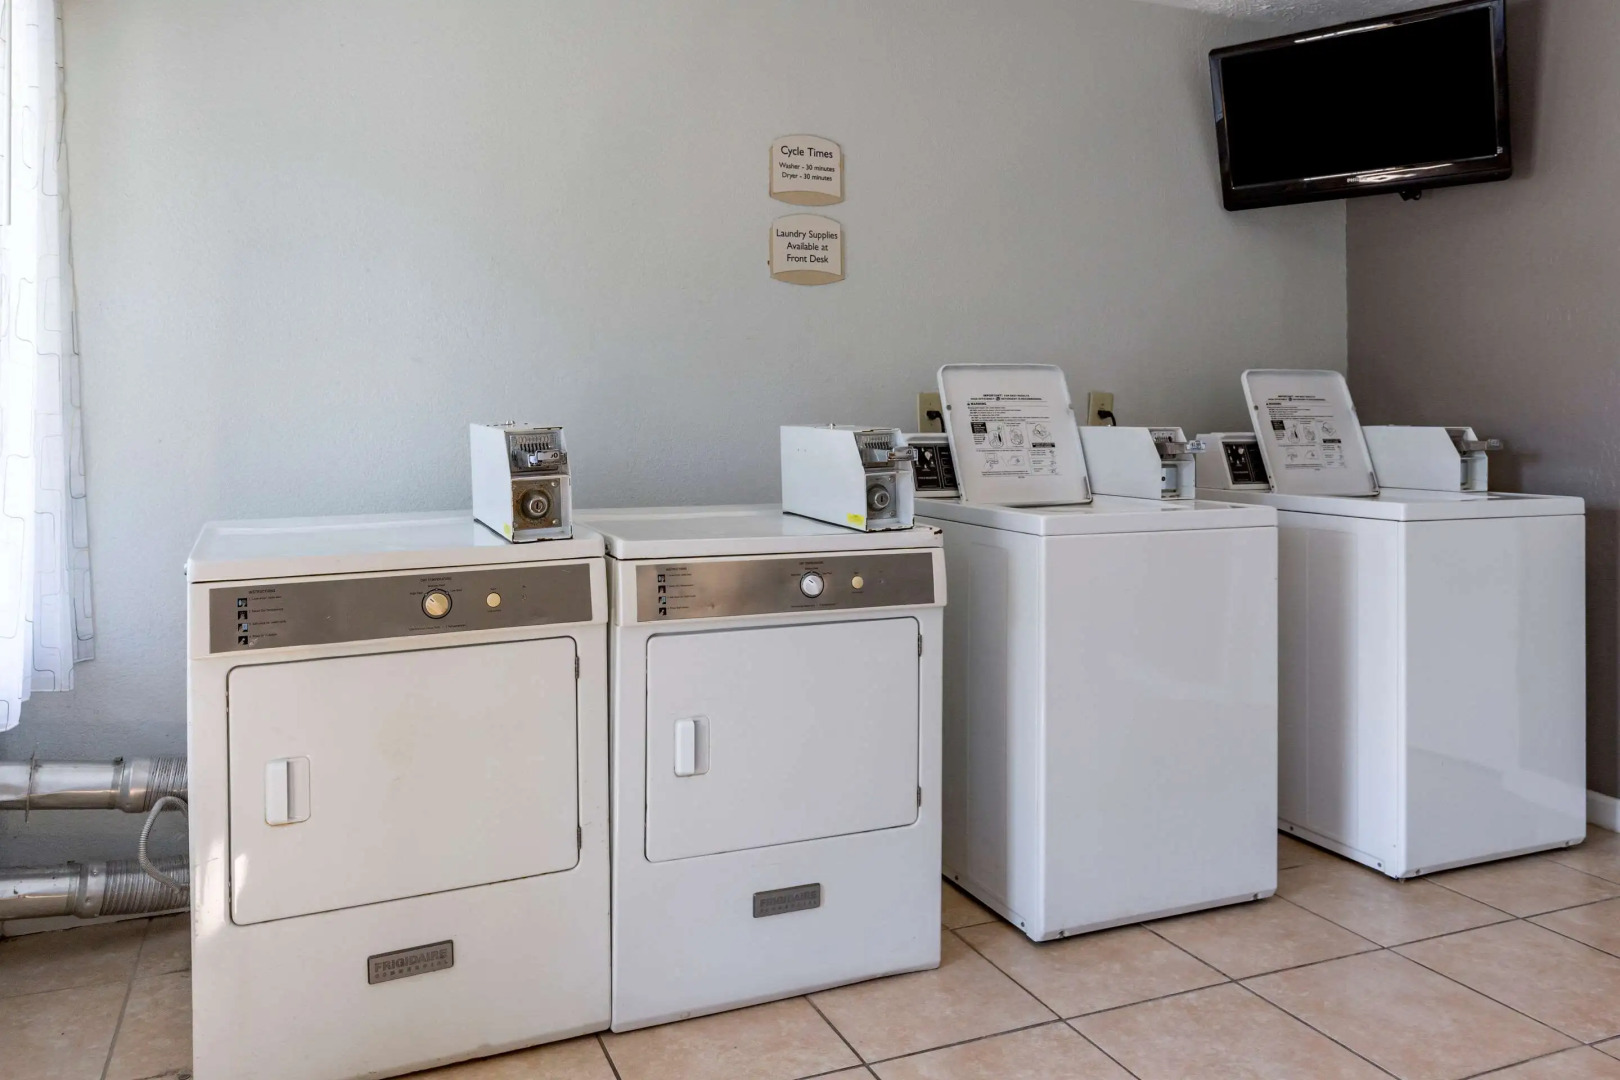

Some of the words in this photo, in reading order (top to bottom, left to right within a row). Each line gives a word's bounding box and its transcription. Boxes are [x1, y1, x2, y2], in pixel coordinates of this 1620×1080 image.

[780, 146, 804, 158] Cycle
[807, 147, 833, 158] Times
[776, 229, 806, 240] Laundry
[808, 230, 838, 240] Supplies
[786, 242, 819, 250] Available
[786, 254, 808, 262] Front
[810, 255, 828, 263] Desk
[374, 948, 448, 973] FRIGIDAIRE
